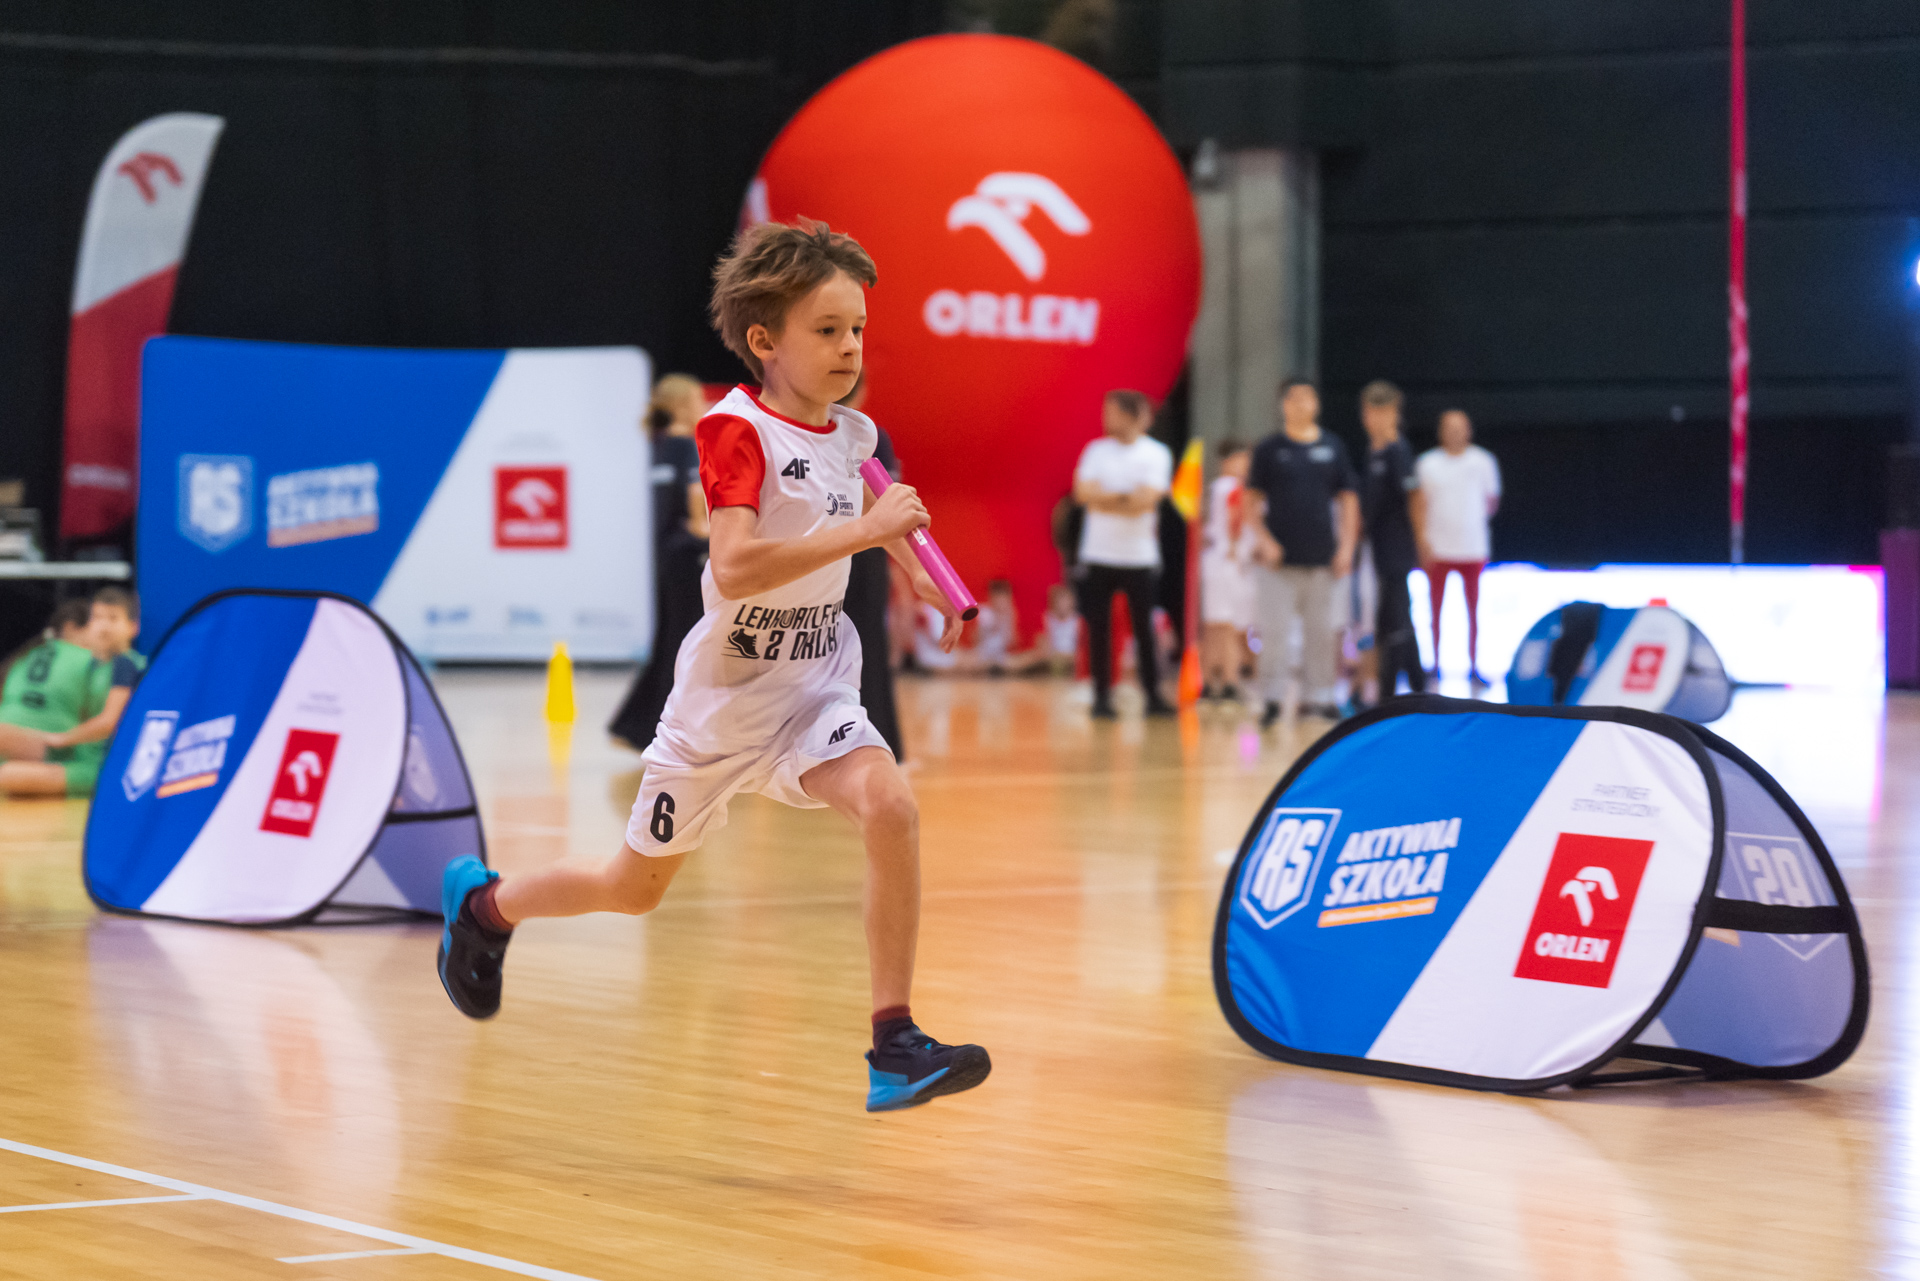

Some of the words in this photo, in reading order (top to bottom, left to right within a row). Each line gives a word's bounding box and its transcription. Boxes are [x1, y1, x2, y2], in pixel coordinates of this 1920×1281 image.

[922, 289, 1100, 345] ORLEN
[781, 457, 810, 480] 4F
[828, 720, 857, 746] 4F
[650, 791, 676, 843] 6
[1336, 817, 1462, 863] AKTYWNA
[1323, 852, 1448, 907] SZKOŁA
[1534, 932, 1611, 963] ORLEN
